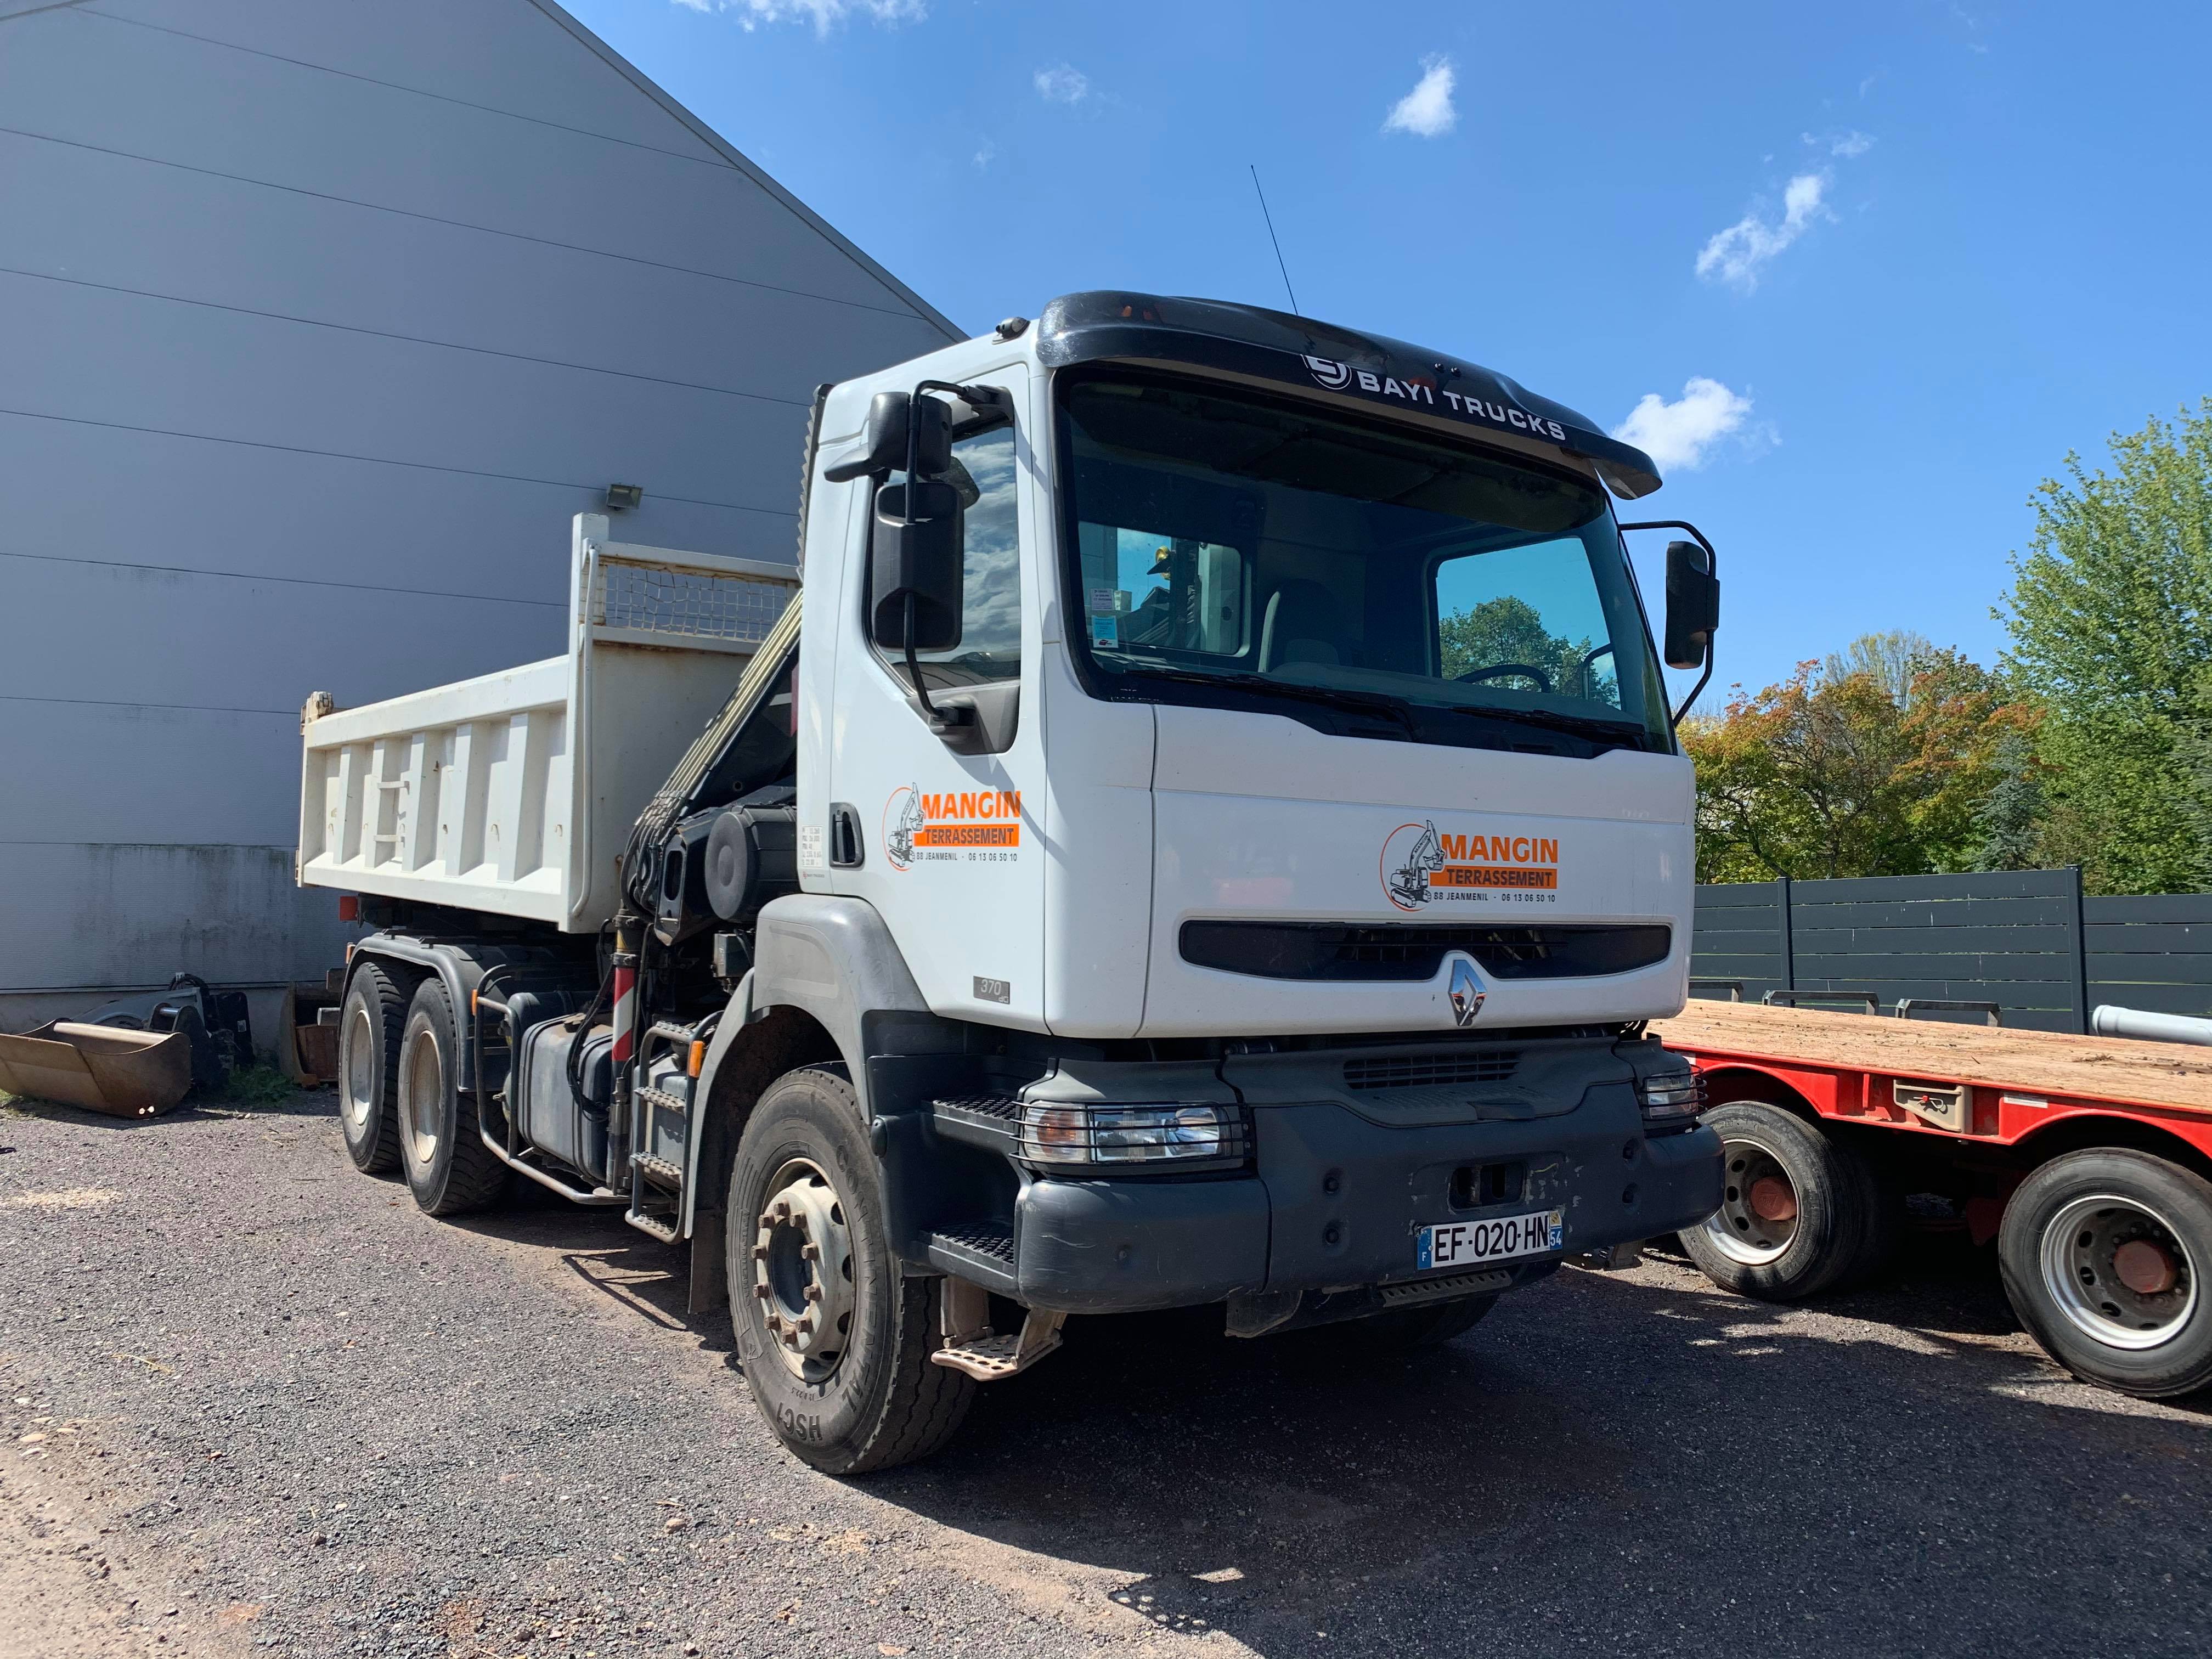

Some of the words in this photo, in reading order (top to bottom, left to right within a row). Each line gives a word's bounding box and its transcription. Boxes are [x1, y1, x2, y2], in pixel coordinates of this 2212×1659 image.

[1356, 371, 1434, 404] BAYI
[1442, 390, 1566, 441] TRUCKS
[922, 791, 1021, 819] MANGIN
[925, 828, 1014, 844] TERRASSEMENT
[916, 851, 923, 860] 88
[926, 852, 957, 860] JEANMENIL
[968, 853, 976, 861] 06
[979, 853, 986, 861] 13
[989, 853, 997, 861] 06
[1000, 853, 1007, 861] 50
[1010, 853, 1017, 861] 10
[1441, 834, 1558, 864] MANGIN
[1447, 868, 1553, 887] TERRASSEMENT
[1447, 892, 1488, 901] JEANMENIL
[1525, 894, 1533, 902] 06
[1536, 894, 1545, 902] 50
[981, 979, 1001, 995] 370
[1550, 1231, 1561, 1247] 54
[1421, 1251, 1427, 1261] F
[836, 1145, 878, 1414] CONTINENTAL
